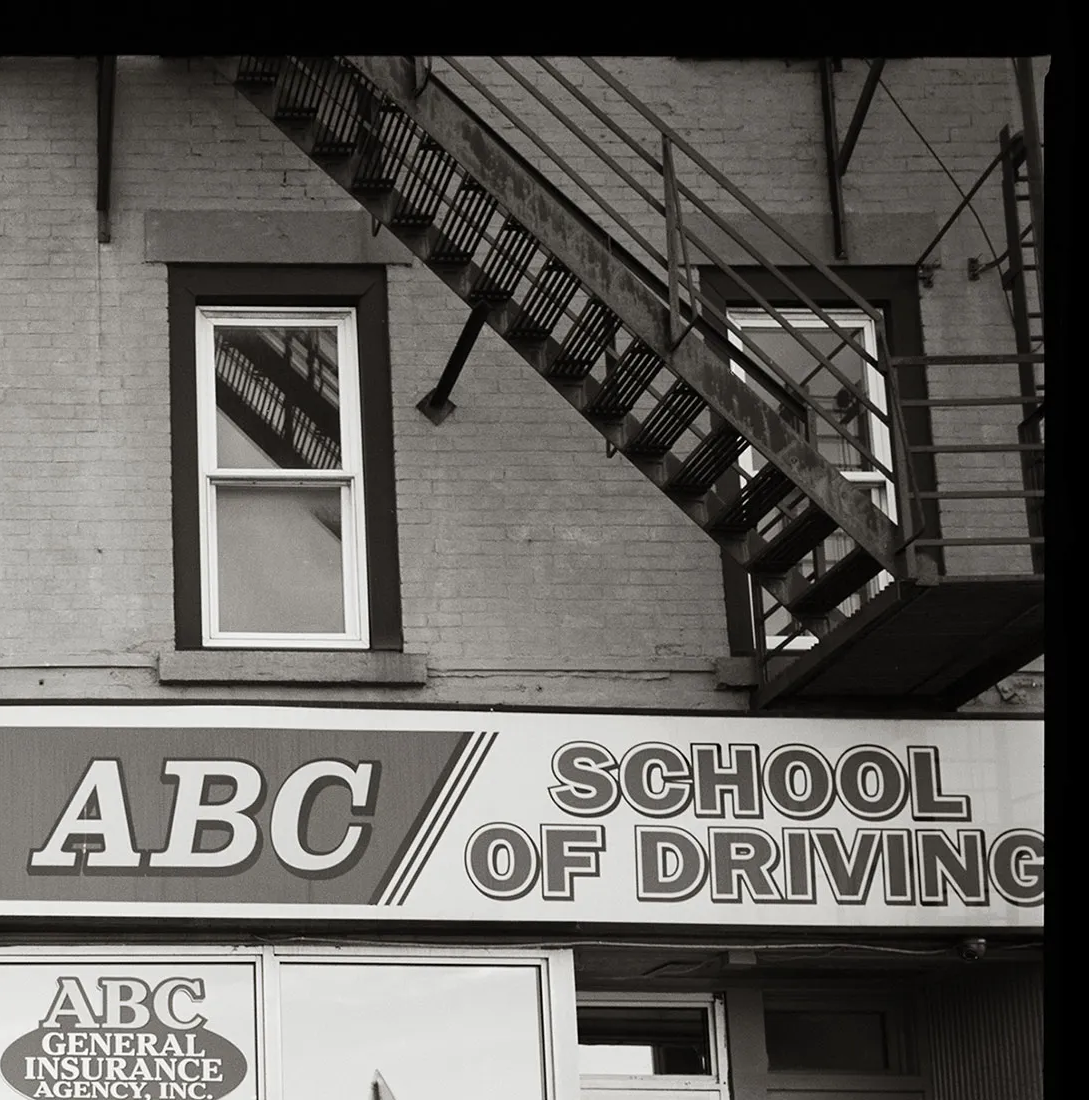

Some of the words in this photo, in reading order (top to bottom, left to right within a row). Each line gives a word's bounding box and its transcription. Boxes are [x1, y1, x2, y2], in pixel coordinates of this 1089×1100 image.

[547, 740, 971, 822] SCHOOL
[29, 757, 379, 876] ABC
[464, 821, 606, 902] OF
[634, 823, 1045, 907] DRIVING
[39, 976, 208, 1030] ABC
[24, 1056, 223, 1082] INSURANCE
[41, 1032, 205, 1057] GENERAL
[159, 1082, 213, 1100] INC.
